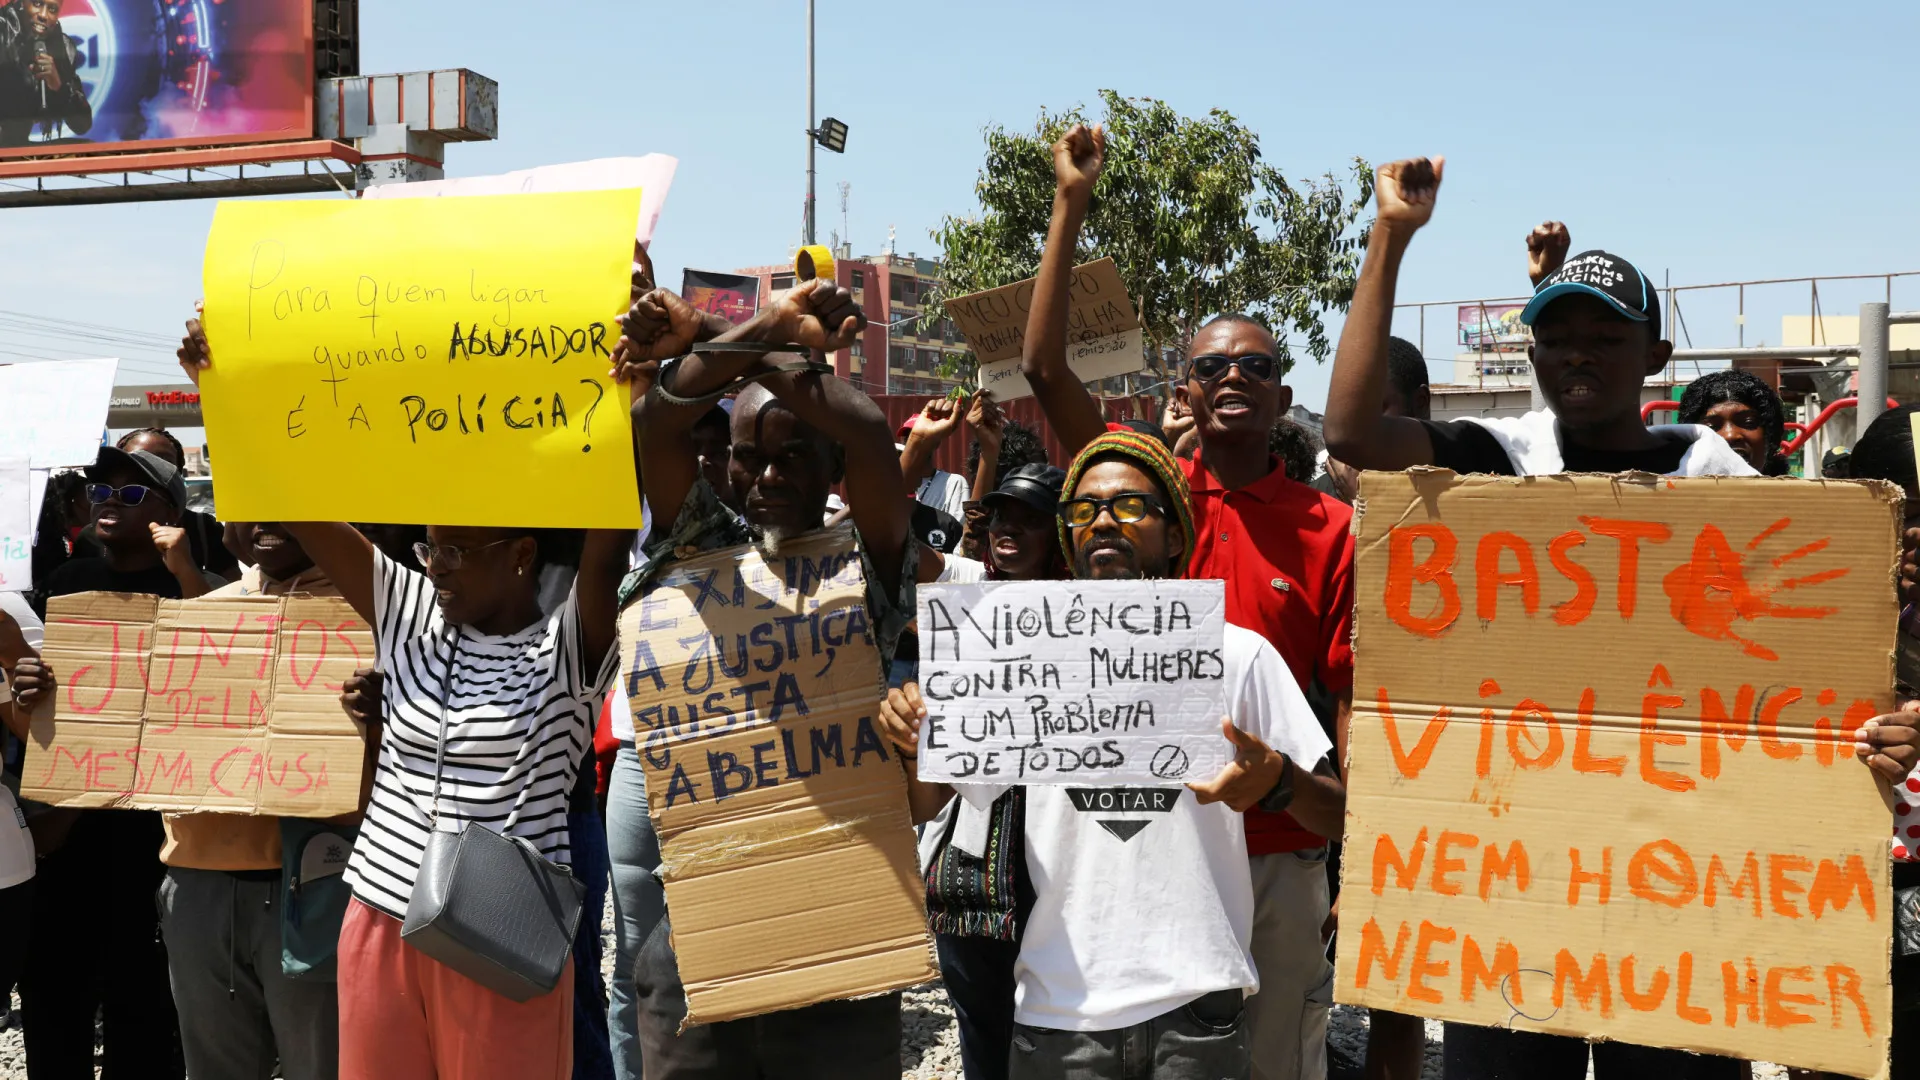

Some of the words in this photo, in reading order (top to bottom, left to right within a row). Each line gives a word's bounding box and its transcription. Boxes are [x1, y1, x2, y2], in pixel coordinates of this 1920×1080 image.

[248, 239, 332, 341] Para
[471, 268, 549, 327] ligar
[1550, 264, 1624, 285] WILLIAMS
[953, 295, 1011, 327] MEU
[312, 330, 428, 407] quando
[287, 395, 307, 439] É
[348, 402, 371, 431] A
[1384, 515, 1757, 640] BASTA
[68, 613, 362, 714] JUNTOS
[629, 640, 668, 698] A
[925, 653, 1062, 701] CONTRA
[1089, 647, 1225, 689] MULHERES
[926, 704, 949, 750] É
[961, 706, 1016, 742] UM
[40, 745, 195, 797] MESMA
[209, 746, 330, 797] CAUSA
[665, 763, 702, 811] A
[706, 716, 890, 804] BELMA
[1081, 791, 1166, 809] VOTAR
[1371, 825, 1531, 903] NEM
[1567, 838, 1877, 921] HOMEM
[1355, 916, 1524, 1005] NEM
[1551, 948, 1878, 1039] MULHER
